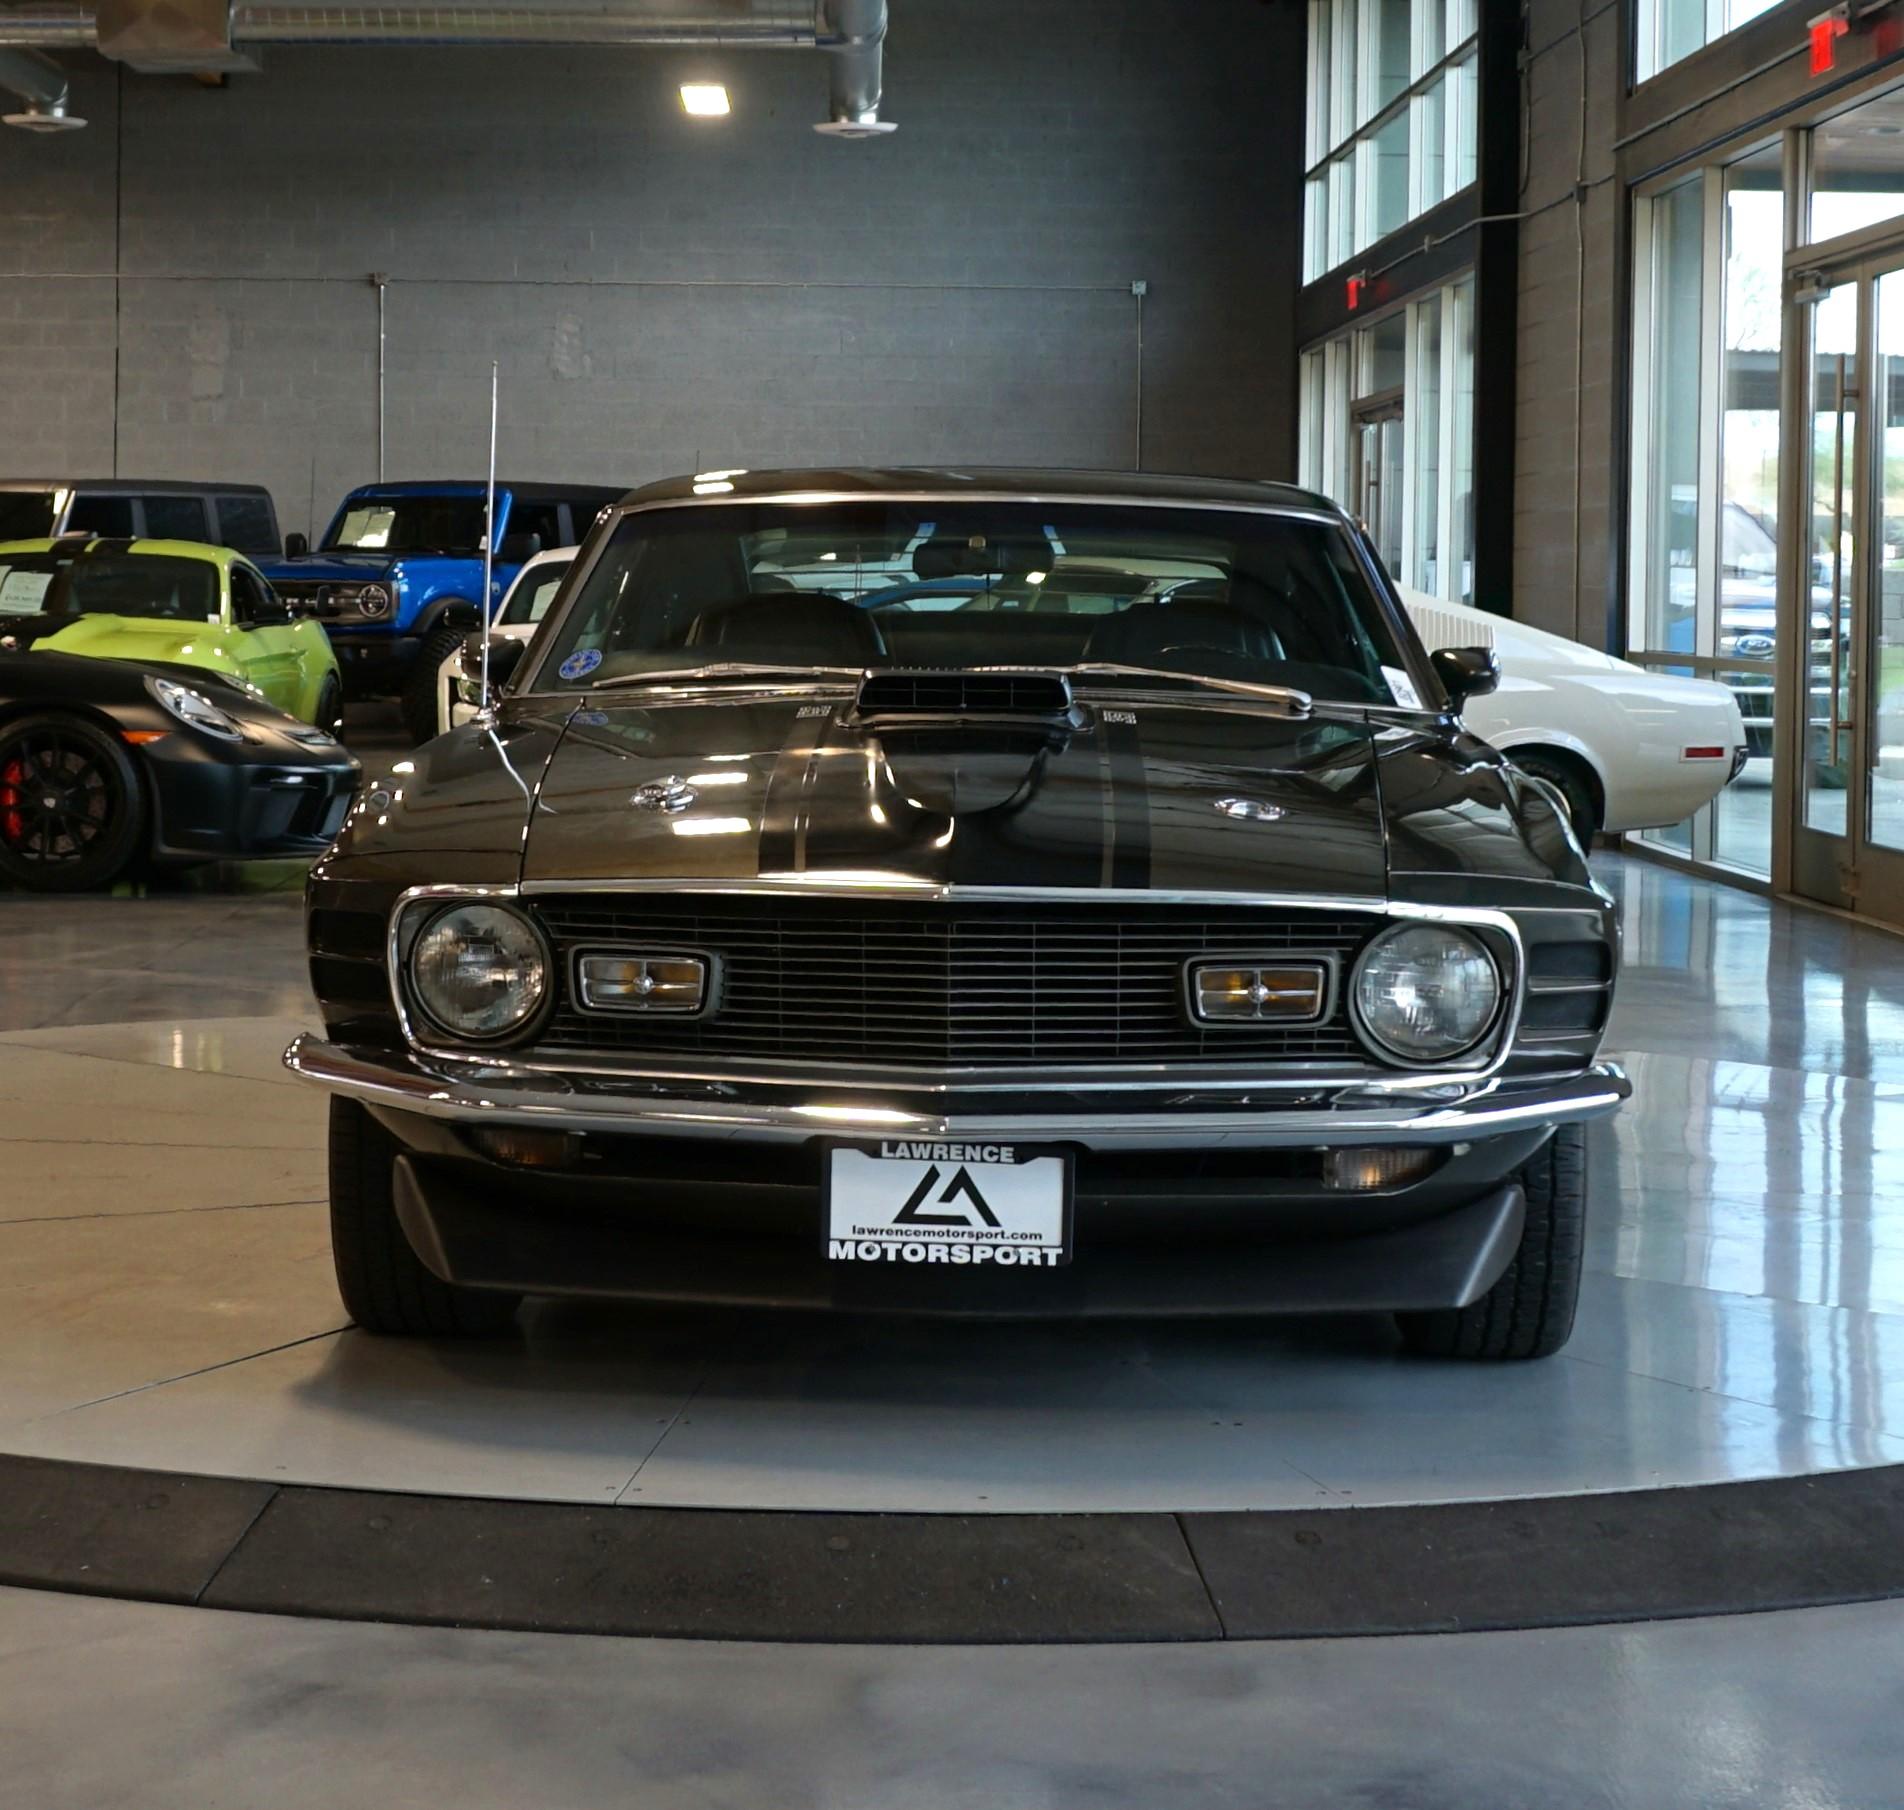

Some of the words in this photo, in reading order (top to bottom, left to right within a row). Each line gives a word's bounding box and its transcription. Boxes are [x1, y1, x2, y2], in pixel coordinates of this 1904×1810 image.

[881, 1141, 1015, 1163] LAWRENCE
[852, 1224, 1043, 1241] lawrencemotorsport.com
[828, 1239, 1063, 1266] MOTORSPORT
